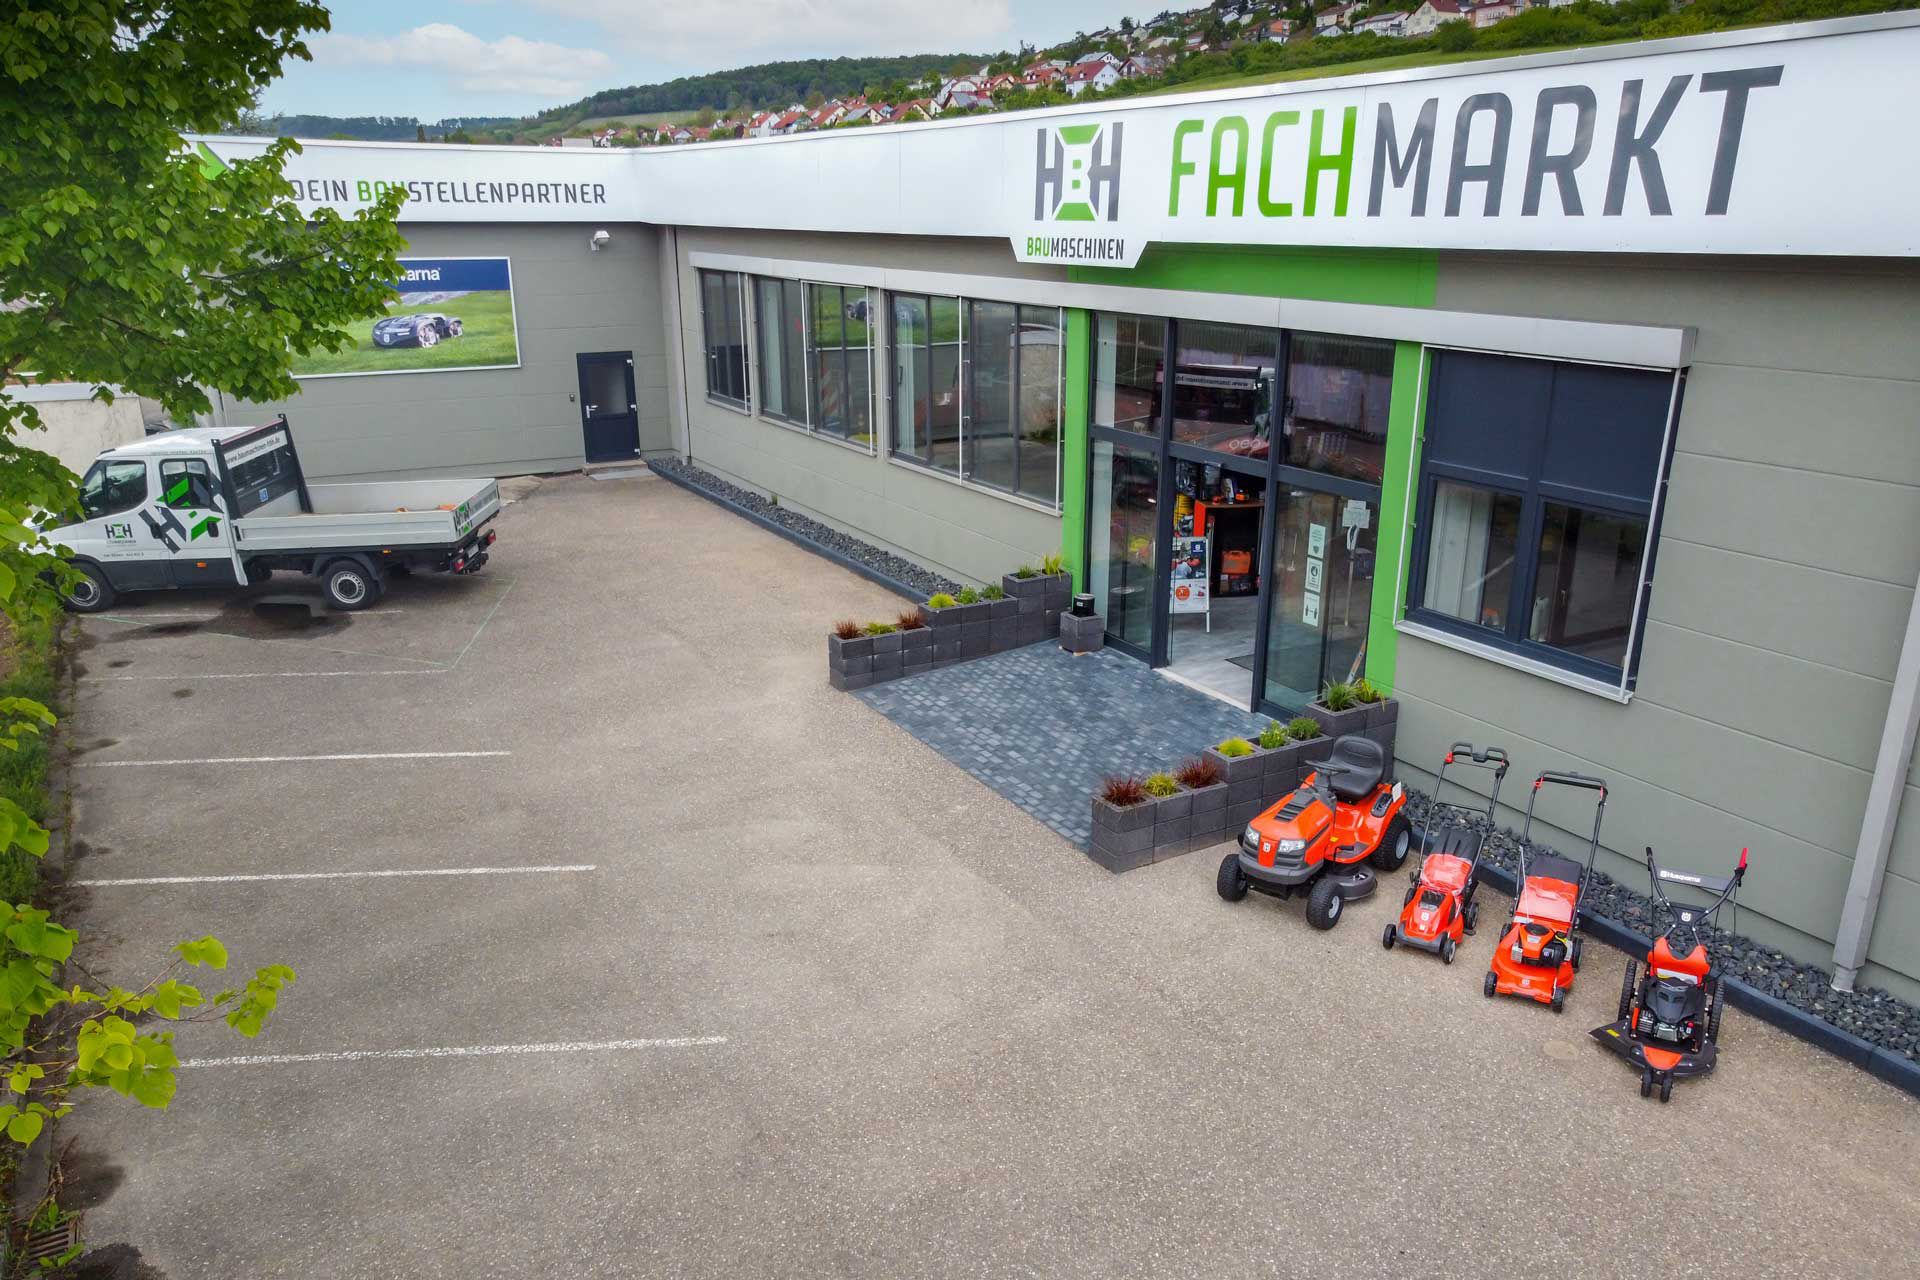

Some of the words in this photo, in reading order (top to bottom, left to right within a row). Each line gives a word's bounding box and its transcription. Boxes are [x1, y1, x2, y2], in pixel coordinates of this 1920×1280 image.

[1168, 65, 1785, 218] FACHMARKT
[290, 179, 348, 202] DEIN
[1026, 236, 1125, 261] BAUMASCHINEN
